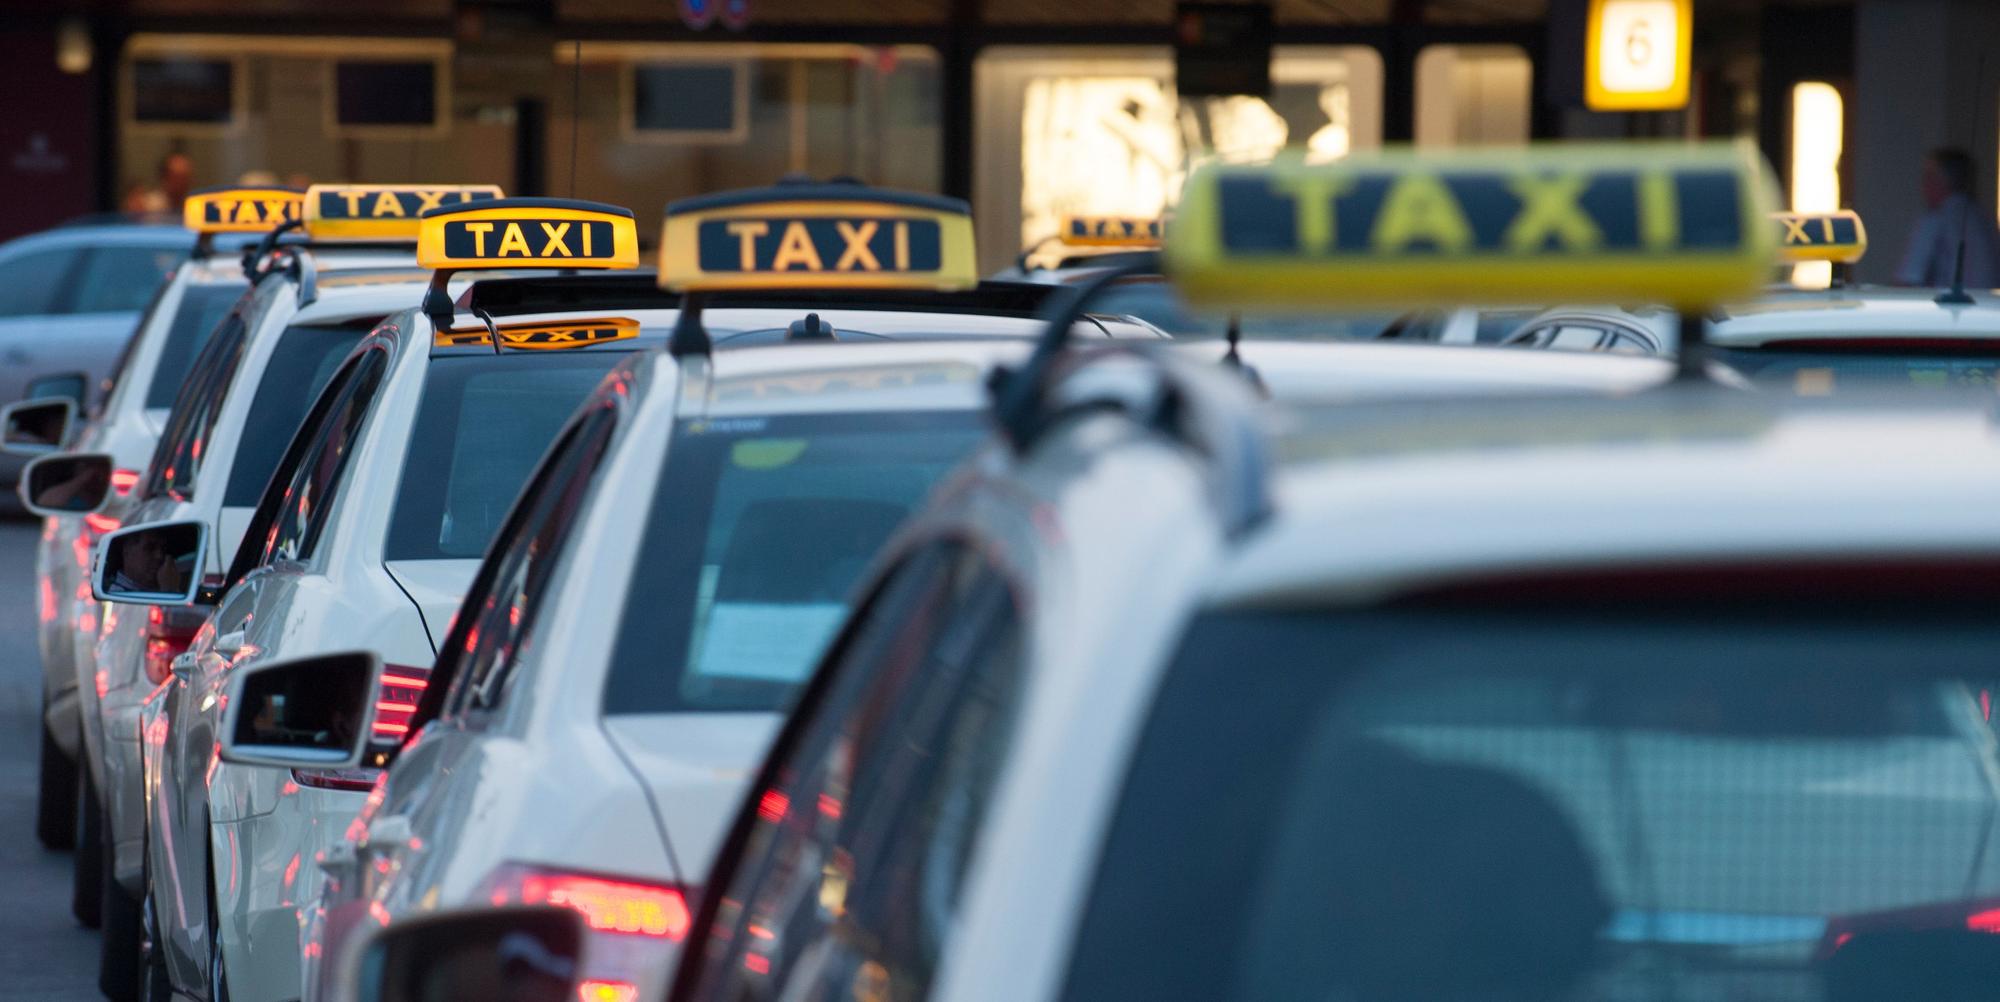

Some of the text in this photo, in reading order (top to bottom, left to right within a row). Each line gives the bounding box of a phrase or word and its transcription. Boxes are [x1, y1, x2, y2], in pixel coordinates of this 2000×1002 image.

[1624, 17, 1653, 67] 6
[1272, 169, 1682, 252] TAXI
[465, 222, 593, 257] TAXI
[726, 220, 911, 271] TAXI
